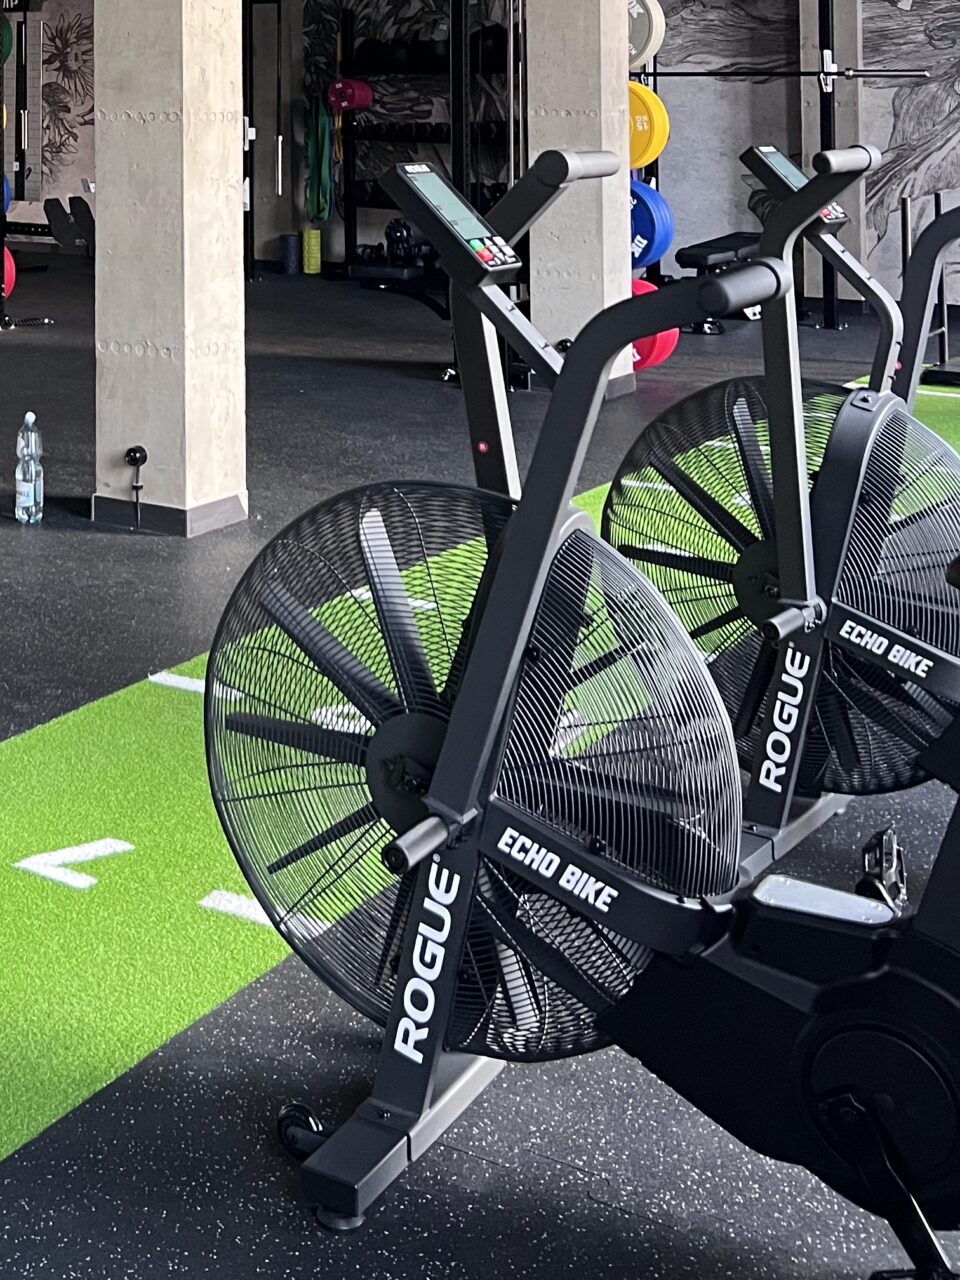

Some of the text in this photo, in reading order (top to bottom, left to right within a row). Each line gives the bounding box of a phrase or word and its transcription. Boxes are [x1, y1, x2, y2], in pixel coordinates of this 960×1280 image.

[839, 619, 934, 678] ECHO BIKE
[758, 647, 811, 793] ROGUE
[497, 827, 619, 913] ECHO BIKE
[394, 862, 461, 1065] ROGUE
